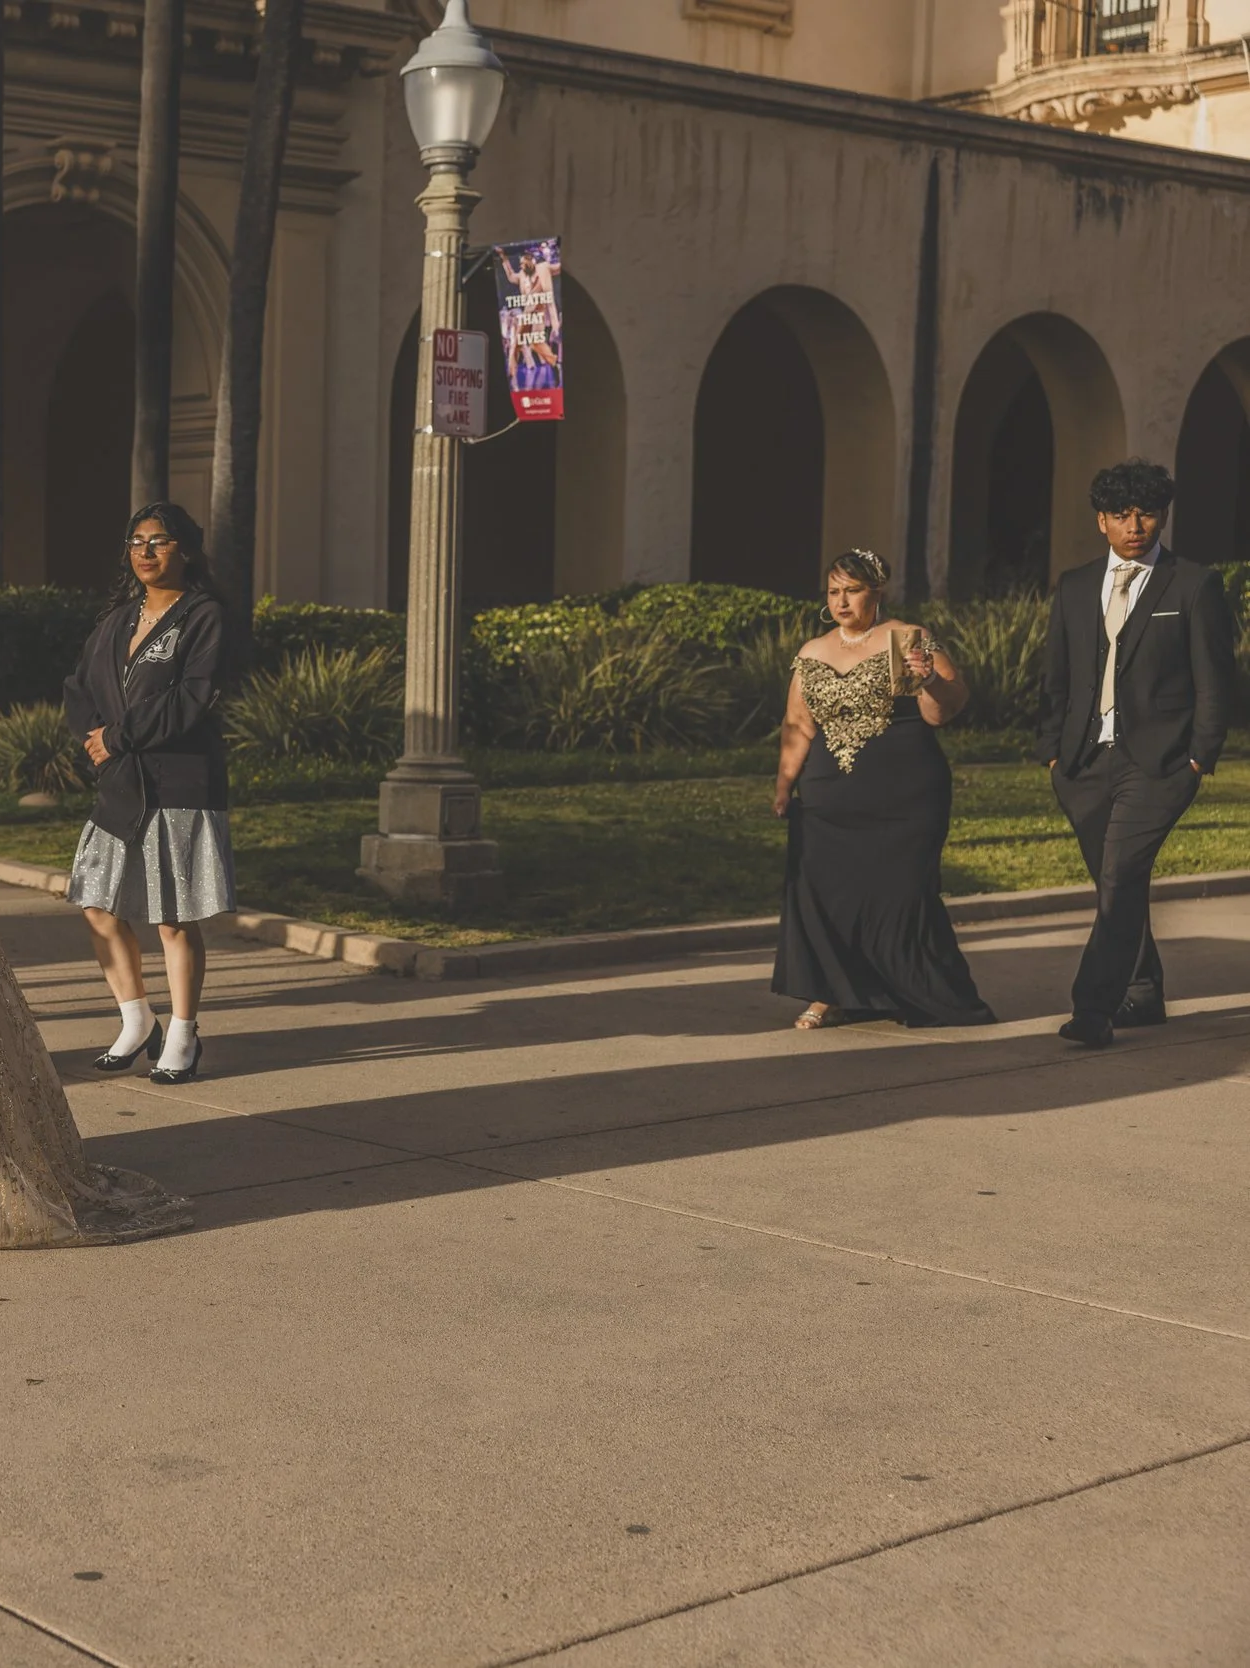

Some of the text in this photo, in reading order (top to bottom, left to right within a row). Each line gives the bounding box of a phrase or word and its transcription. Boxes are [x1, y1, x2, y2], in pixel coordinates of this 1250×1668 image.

[505, 291, 553, 308] THEATRE
[516, 312, 544, 325] THAT
[436, 333, 455, 358] NO
[517, 331, 546, 345] LIVES
[436, 366, 483, 389] STOPPING
[448, 390, 469, 406] FIRE
[446, 409, 470, 425] LANE
